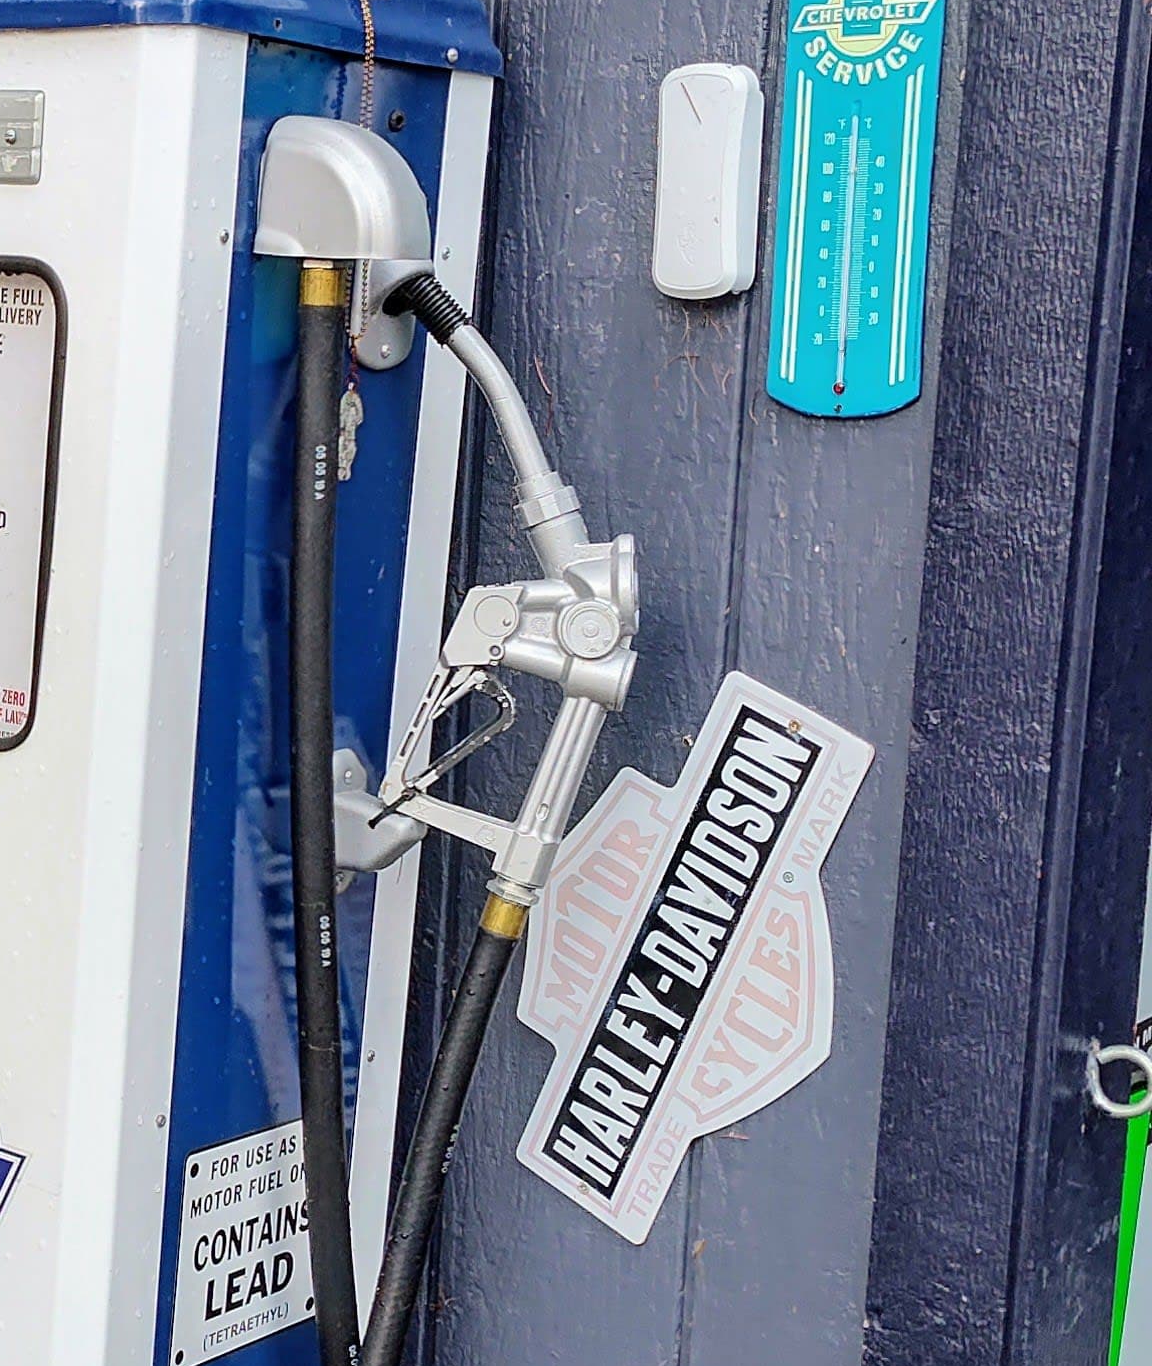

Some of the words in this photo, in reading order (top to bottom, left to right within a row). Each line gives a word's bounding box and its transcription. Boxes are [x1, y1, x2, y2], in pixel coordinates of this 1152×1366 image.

[807, 3, 918, 24] CHEVROLET
[804, 30, 923, 85] SERVICE
[13, 288, 45, 306] FULL
[2, 690, 26, 707] ZERO
[546, 818, 656, 1014] MOTOR
[552, 717, 808, 1187] HARLEY-DAVIDSON
[626, 1116, 688, 1217] TRADE
[791, 768, 858, 869] MARK
[691, 906, 803, 1102] CYCLES
[211, 1153, 239, 1180] FOR
[246, 1142, 273, 1169] USE
[278, 1135, 297, 1156] AS
[190, 1184, 242, 1219] MOTOR
[249, 1169, 283, 1198] FUEL
[194, 1198, 311, 1272] CONTAINS
[205, 1251, 294, 1321] LEAD
[203, 1302, 289, 1352] (TETRAETHYL)
